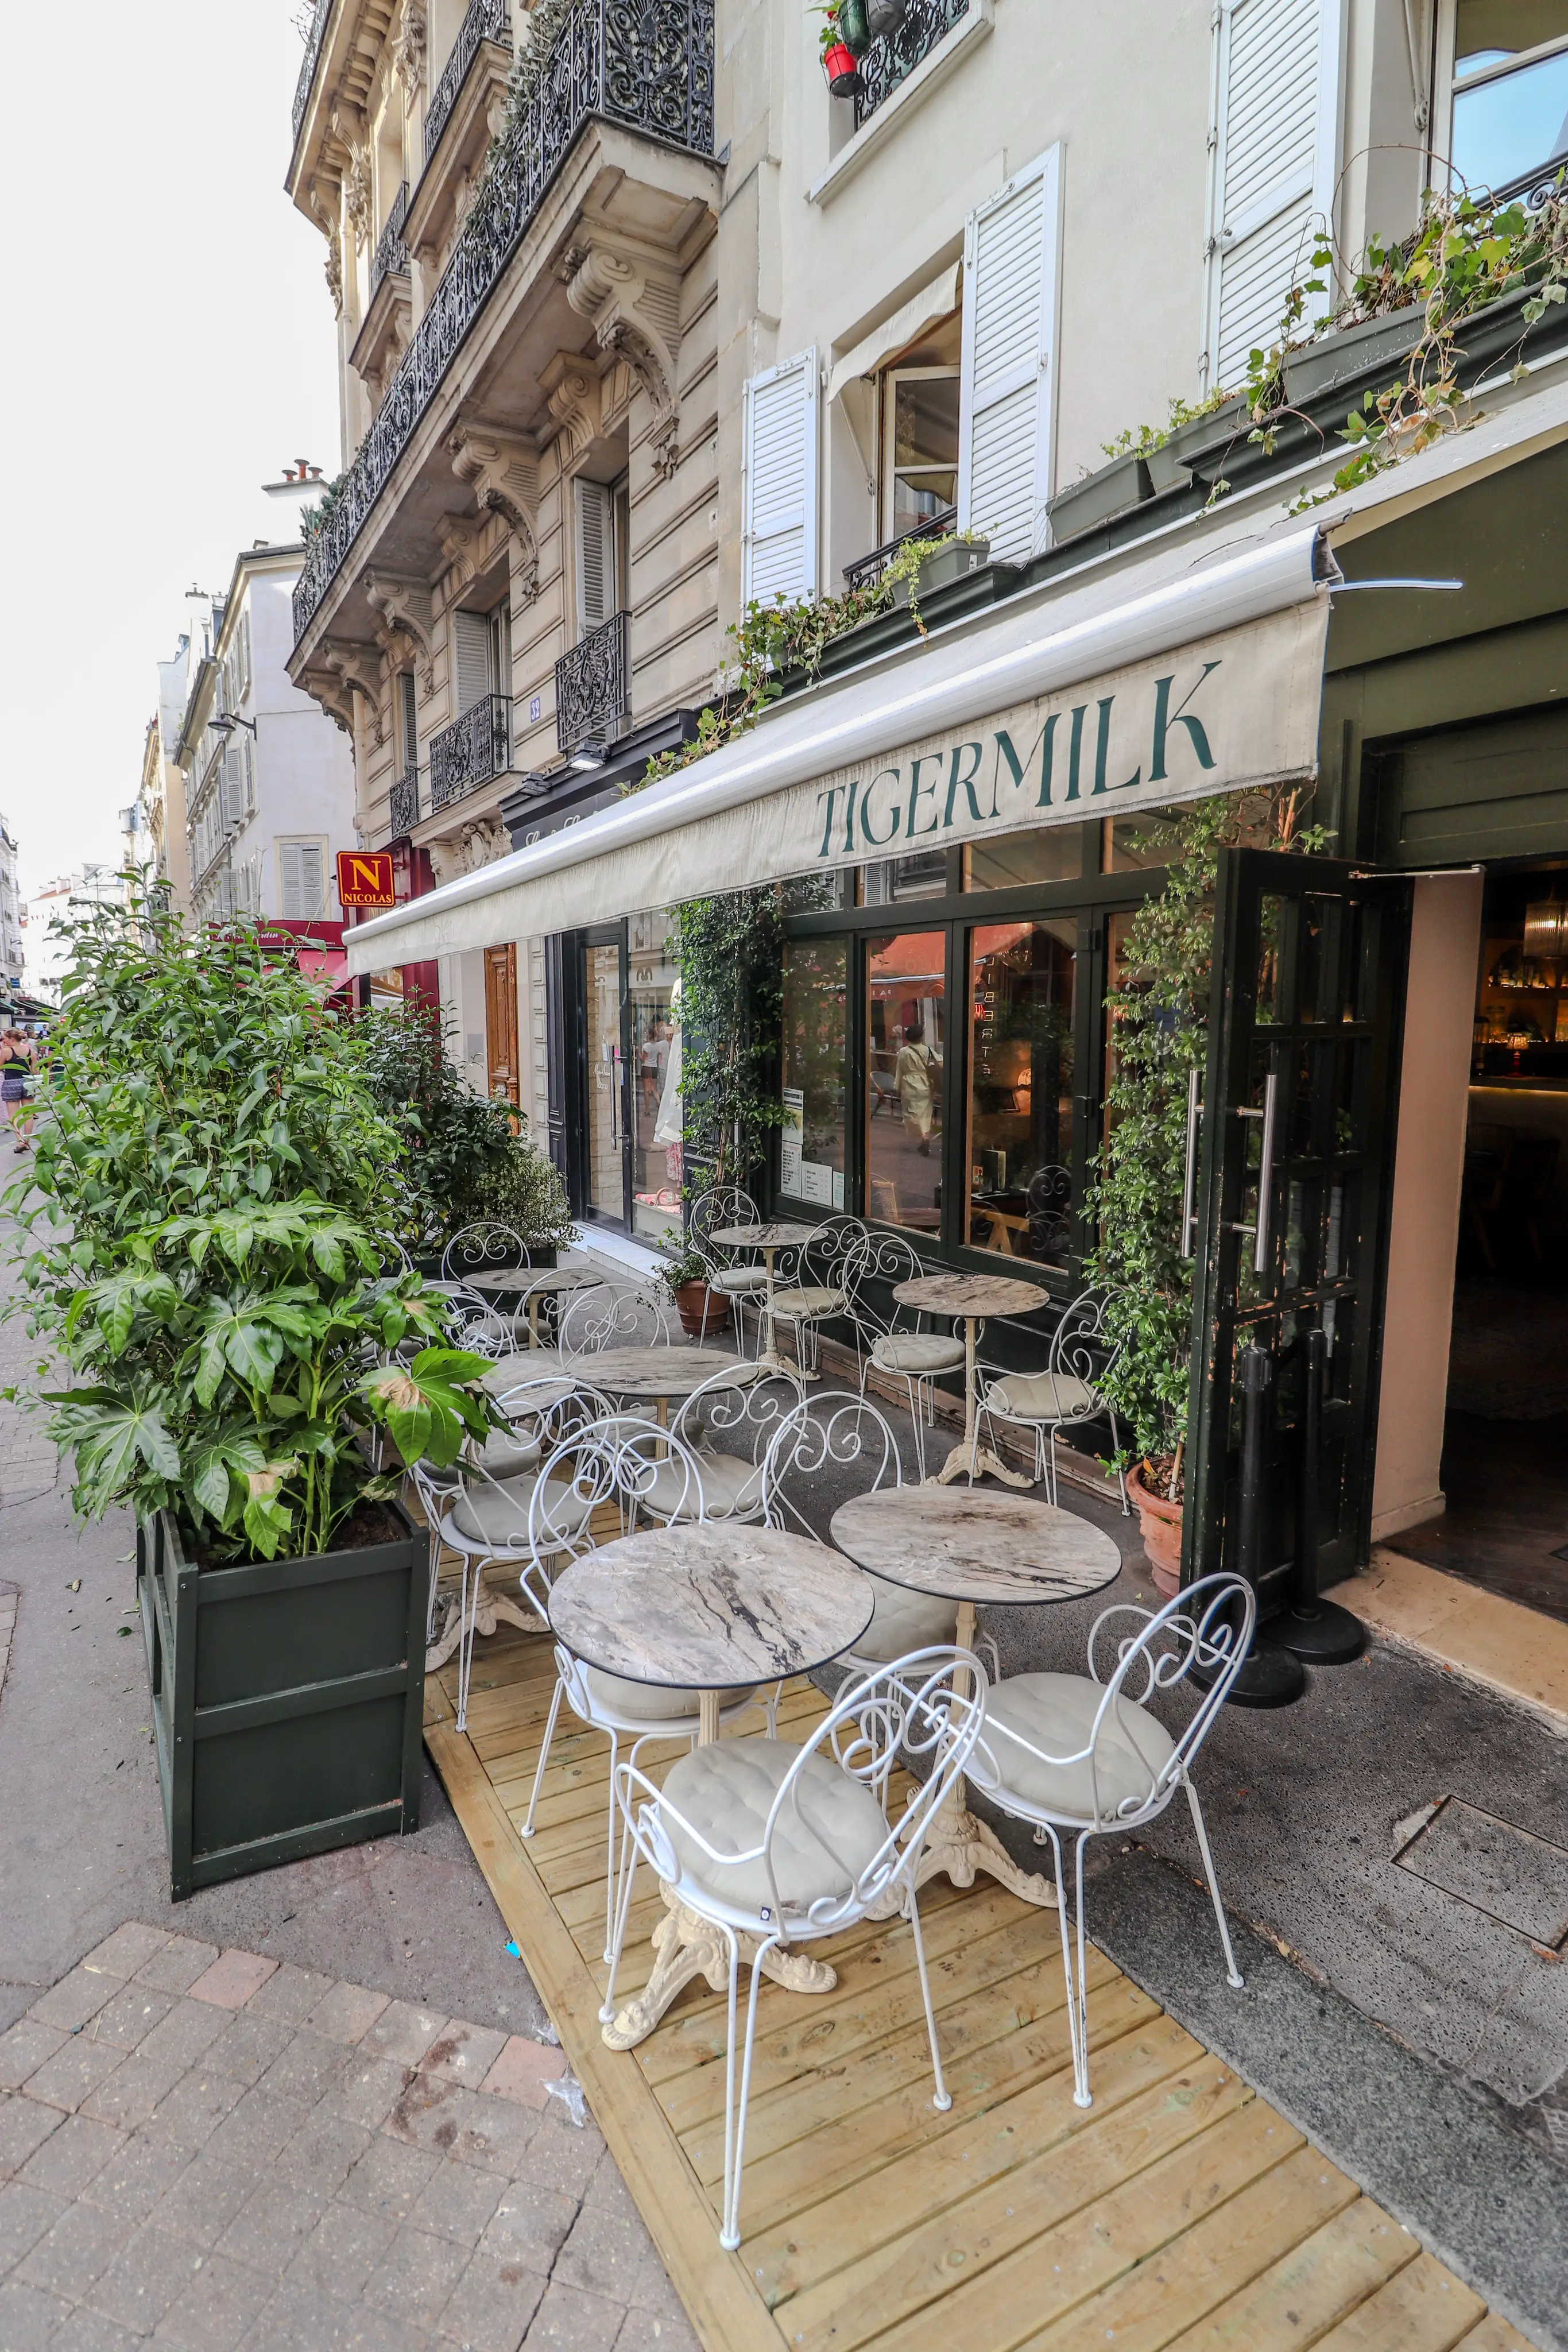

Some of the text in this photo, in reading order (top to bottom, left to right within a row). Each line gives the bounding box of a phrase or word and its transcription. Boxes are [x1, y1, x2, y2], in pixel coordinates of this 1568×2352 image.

[532, 699, 540, 720] 32
[817, 660, 1222, 857] TIGERMILK
[349, 859, 381, 891] N
[344, 893, 392, 903] NICOLAS
